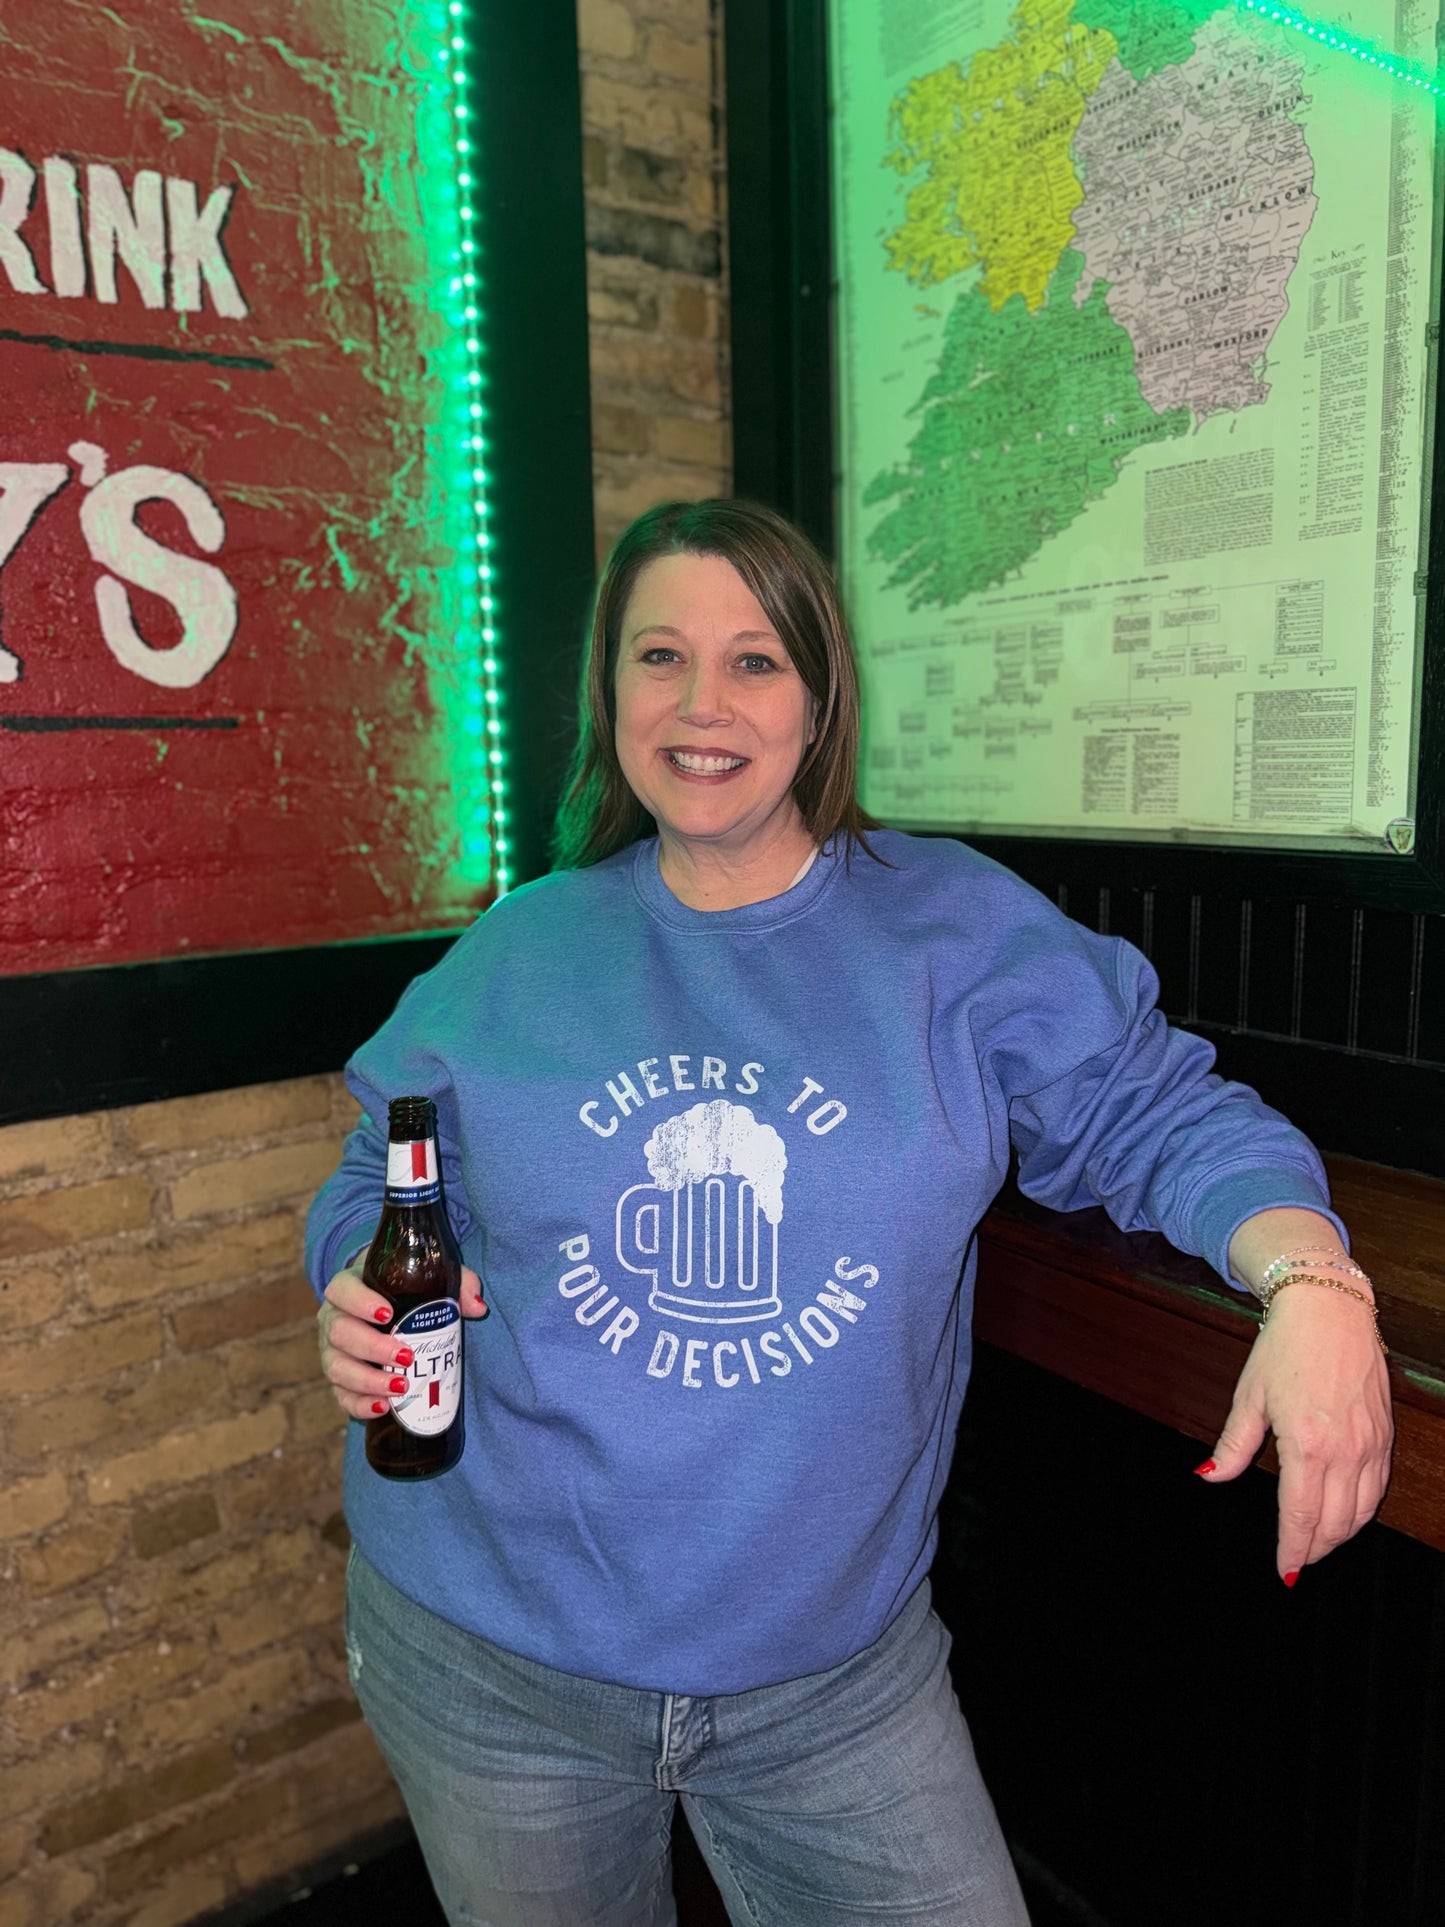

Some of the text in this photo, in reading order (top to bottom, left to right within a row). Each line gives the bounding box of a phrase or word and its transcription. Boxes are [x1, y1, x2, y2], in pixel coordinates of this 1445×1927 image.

[1258, 95, 1303, 119] DUBLIN
[1188, 175, 1237, 200] KILDARE
[1224, 185, 1307, 222] WICKLOW
[1184, 285, 1229, 305] CARLOW
[1213, 328, 1268, 350] WEXFORD
[579, 1054, 848, 1138] CHEERS TO
[415, 1306, 451, 1321] SUPERIOR
[558, 1234, 880, 1388] POUR DECISIONS
[411, 1319, 435, 1329] LIGHT
[391, 1343, 461, 1378] LTR
